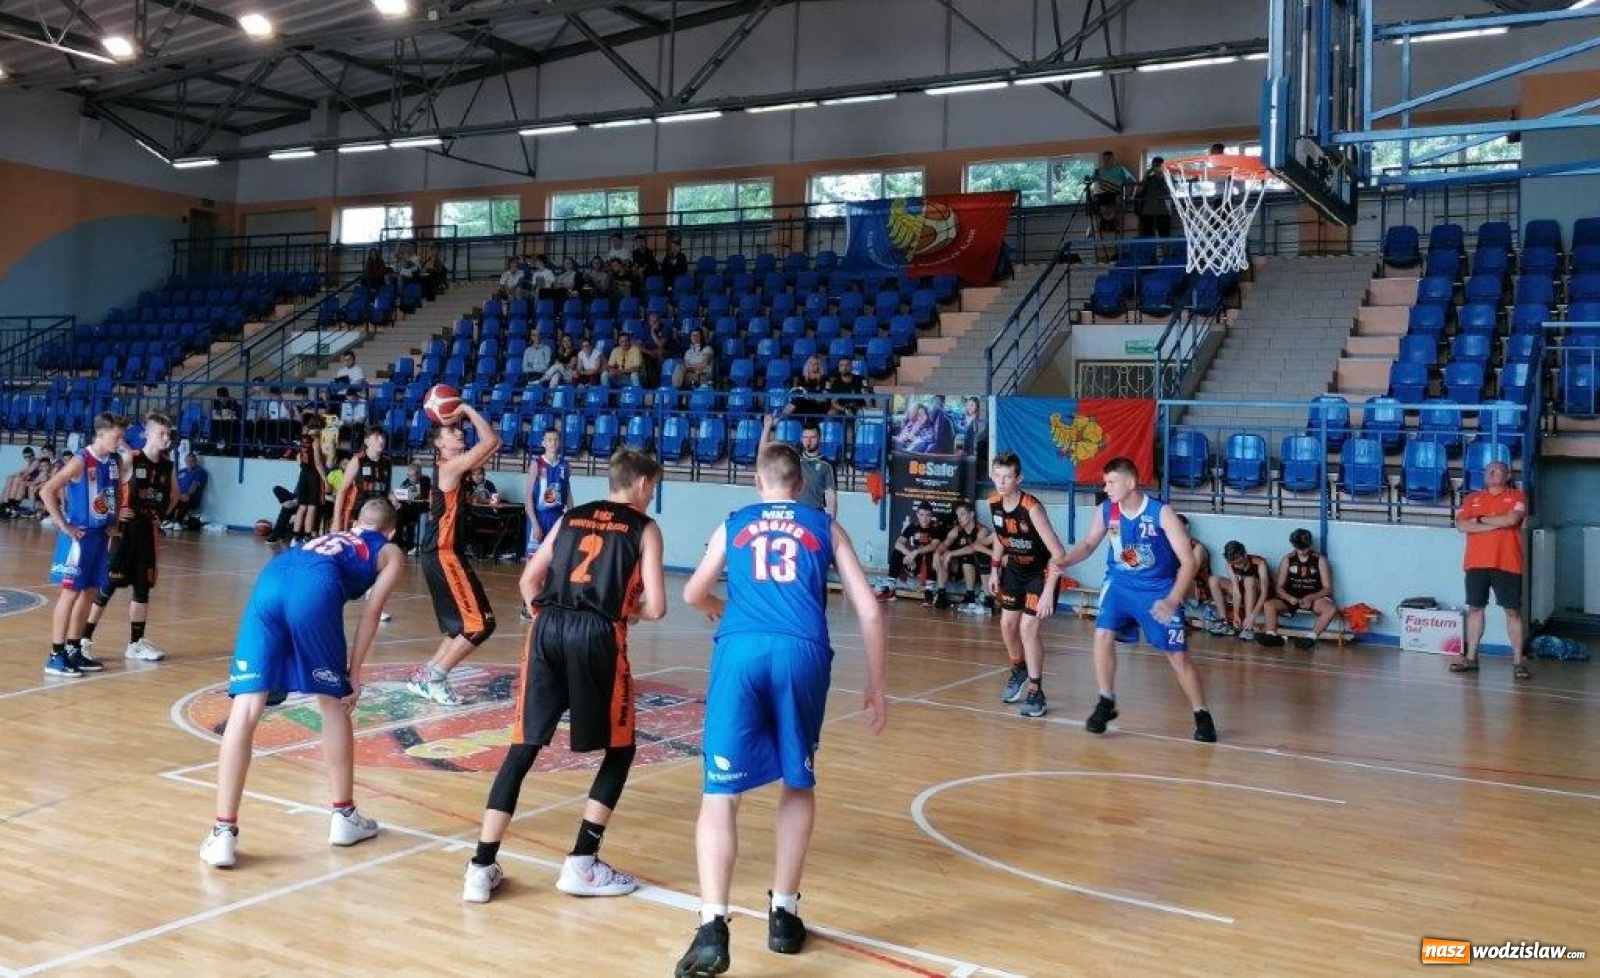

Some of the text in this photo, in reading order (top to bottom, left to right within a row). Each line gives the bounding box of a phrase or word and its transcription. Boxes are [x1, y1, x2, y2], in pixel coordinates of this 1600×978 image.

[908, 460, 956, 477] BeSafe
[762, 509, 796, 520] MKS
[569, 533, 602, 584] 2
[750, 535, 797, 583] 13
[1405, 614, 1457, 628] Fastum
[1168, 628, 1184, 645] 24
